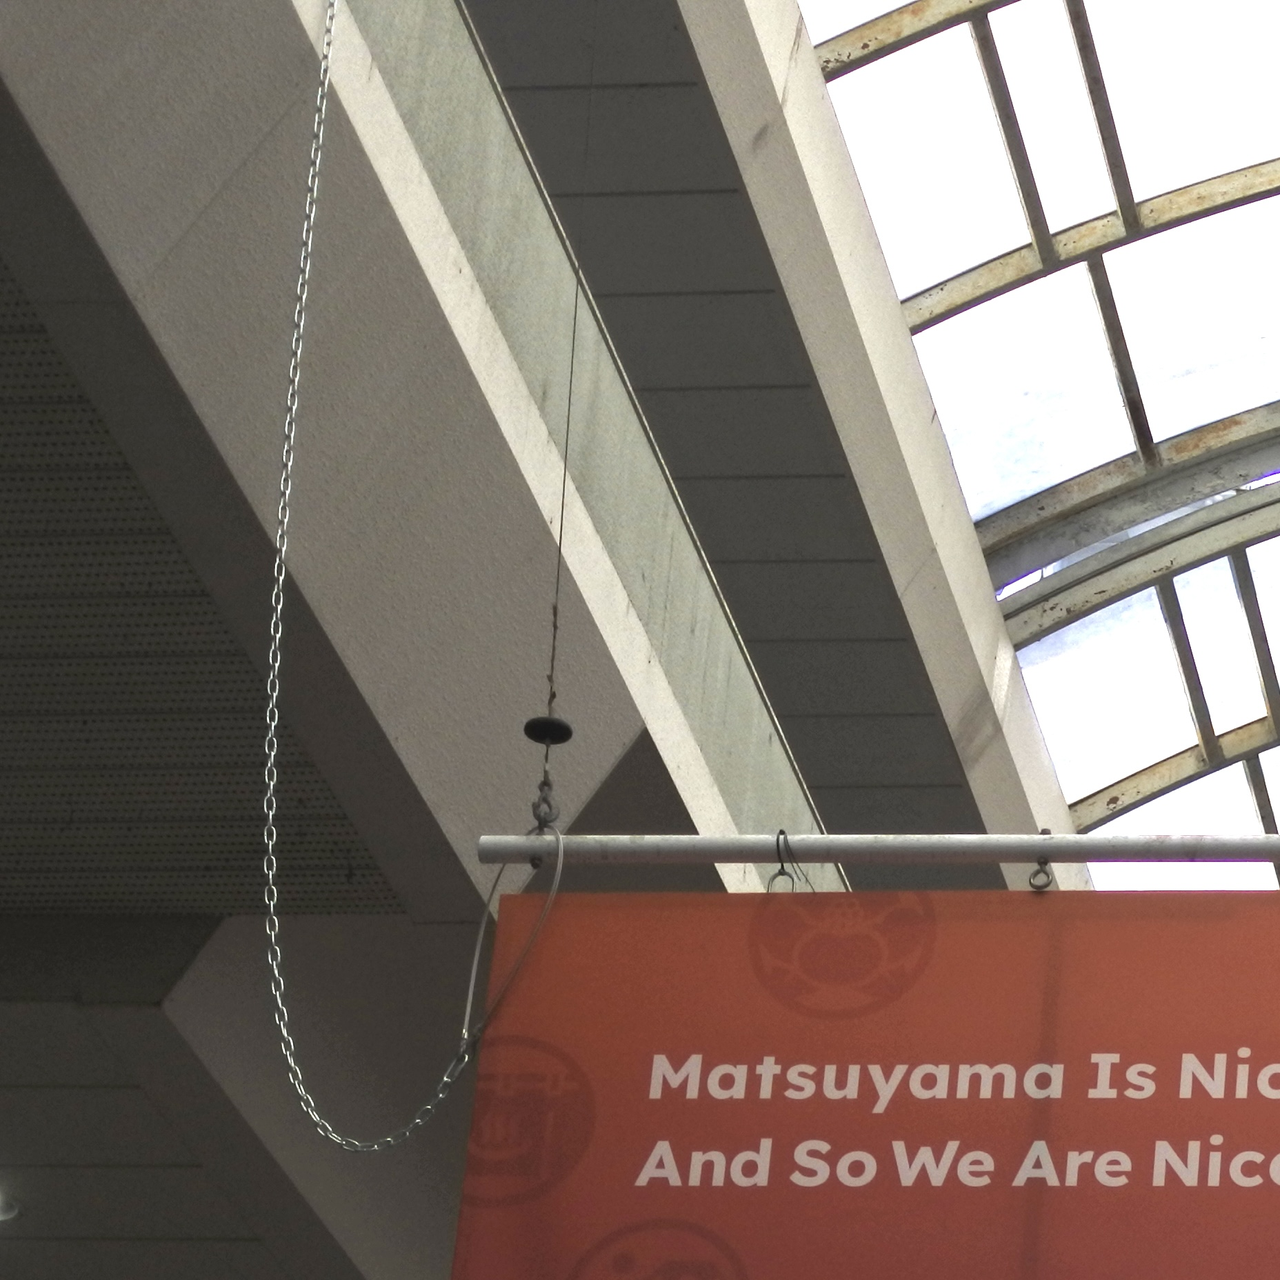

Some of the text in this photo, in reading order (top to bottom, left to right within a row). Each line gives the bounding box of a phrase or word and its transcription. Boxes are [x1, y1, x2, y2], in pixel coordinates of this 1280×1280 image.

[649, 1054, 1065, 1114] Matsuyama
[1087, 1053, 1157, 1100] Is
[634, 1137, 773, 1187] And
[789, 1139, 878, 1187] So
[891, 1140, 995, 1187] We
[1011, 1140, 1132, 1187] Are
